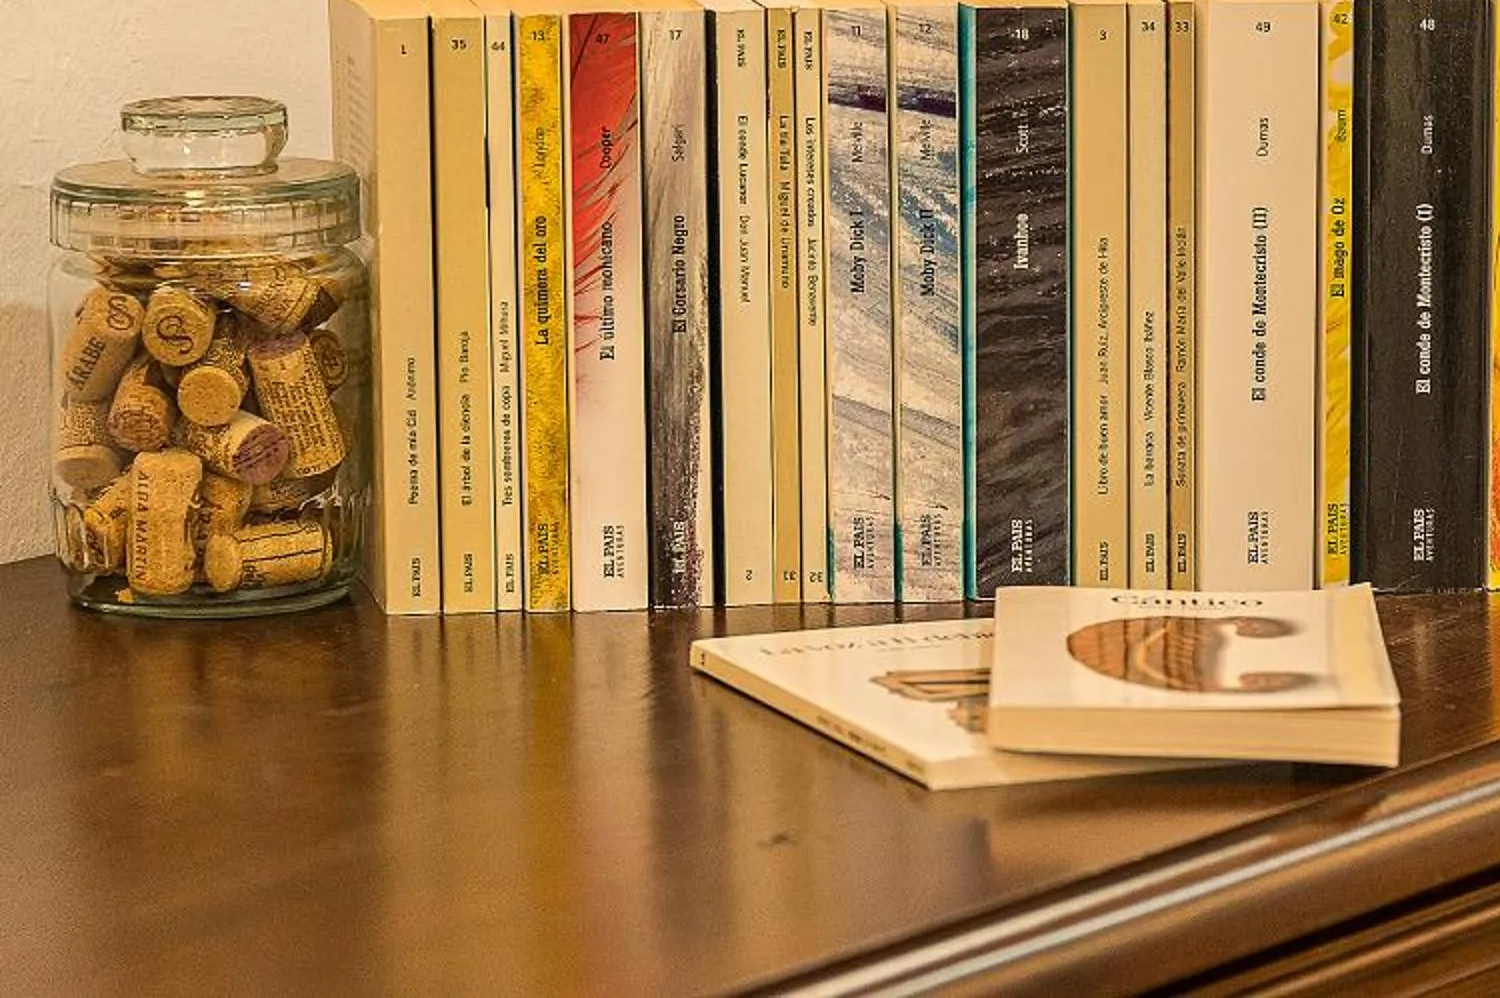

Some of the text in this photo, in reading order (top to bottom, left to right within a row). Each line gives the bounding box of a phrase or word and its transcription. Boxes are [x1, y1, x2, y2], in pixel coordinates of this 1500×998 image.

[851, 25, 862, 37] 11
[1141, 21, 1155, 31] 34
[1175, 21, 1189, 33] 33
[1255, 21, 1271, 32] 49
[1333, 13, 1348, 24] 42
[1419, 18, 1435, 31] 48
[400, 43, 408, 55] 1
[451, 39, 467, 51] 35
[531, 29, 546, 41] 13
[595, 33, 610, 45] 47
[669, 28, 682, 41] 17
[1099, 30, 1108, 41] 3
[779, 115, 790, 128] La
[1420, 114, 1434, 154] Dumas
[598, 125, 613, 170] Cooper
[851, 121, 864, 163] Melville
[1015, 123, 1029, 153] Scott
[1255, 117, 1269, 157] Dumas
[738, 115, 751, 303] El conde Lucanor Don Juan Manuel
[779, 181, 792, 217] Miguel
[781, 219, 791, 234] de
[805, 117, 818, 327] Los intereses creados Jacinto Benavente
[849, 221, 865, 251] Dick
[919, 224, 936, 253] Dick
[1014, 213, 1029, 269] Ivanhoe
[1097, 237, 1108, 259] Hita
[1330, 197, 1348, 297] El mago de Oz
[598, 222, 614, 291] mohicano
[781, 237, 791, 289] Unamuno
[1097, 262, 1108, 274] de
[533, 215, 550, 345] La quimera del oro
[672, 215, 688, 332] El Corsario Negro
[849, 256, 865, 293] Moby
[919, 258, 936, 296] Moby
[1097, 278, 1109, 329] Arcipreste
[1251, 207, 1268, 401] El conde de Montecristo (II)
[1415, 203, 1434, 393] El conde de Montecristo (I)
[459, 331, 470, 362] Baroja
[600, 345, 614, 360] El
[1097, 362, 1108, 384] Juan
[1143, 348, 1155, 380] Blasco
[460, 393, 471, 433] ciencia
[499, 302, 512, 506] Tres sombreros de copa Miguel Mihura
[1097, 395, 1108, 420] amor
[1143, 384, 1155, 420] Vicente
[1176, 382, 1187, 433] primavera
[406, 409, 417, 427] Cid
[460, 434, 471, 444] la
[1097, 423, 1108, 450] buen
[1143, 432, 1155, 470] barraca
[1176, 435, 1187, 447] de
[407, 453, 419, 466] de
[460, 448, 471, 461] de
[1097, 452, 1108, 465] de
[1176, 451, 1187, 487] Sonata
[407, 469, 419, 505] Poema
[1097, 467, 1108, 495] Libro
[1143, 473, 1155, 486] La
[460, 496, 471, 505] El
[853, 517, 864, 569] EL PAIS
[1010, 519, 1023, 572] EL PAIS
[1248, 511, 1259, 563] EL PAIS
[1328, 537, 1339, 554] EL
[1413, 508, 1425, 561] EL PAIS
[1425, 507, 1435, 562] AVENTURAS
[538, 555, 548, 574] EL
[602, 525, 614, 577] EL PAIS
[920, 547, 932, 566] EL
[745, 569, 753, 580] 2
[783, 569, 797, 580] 31
